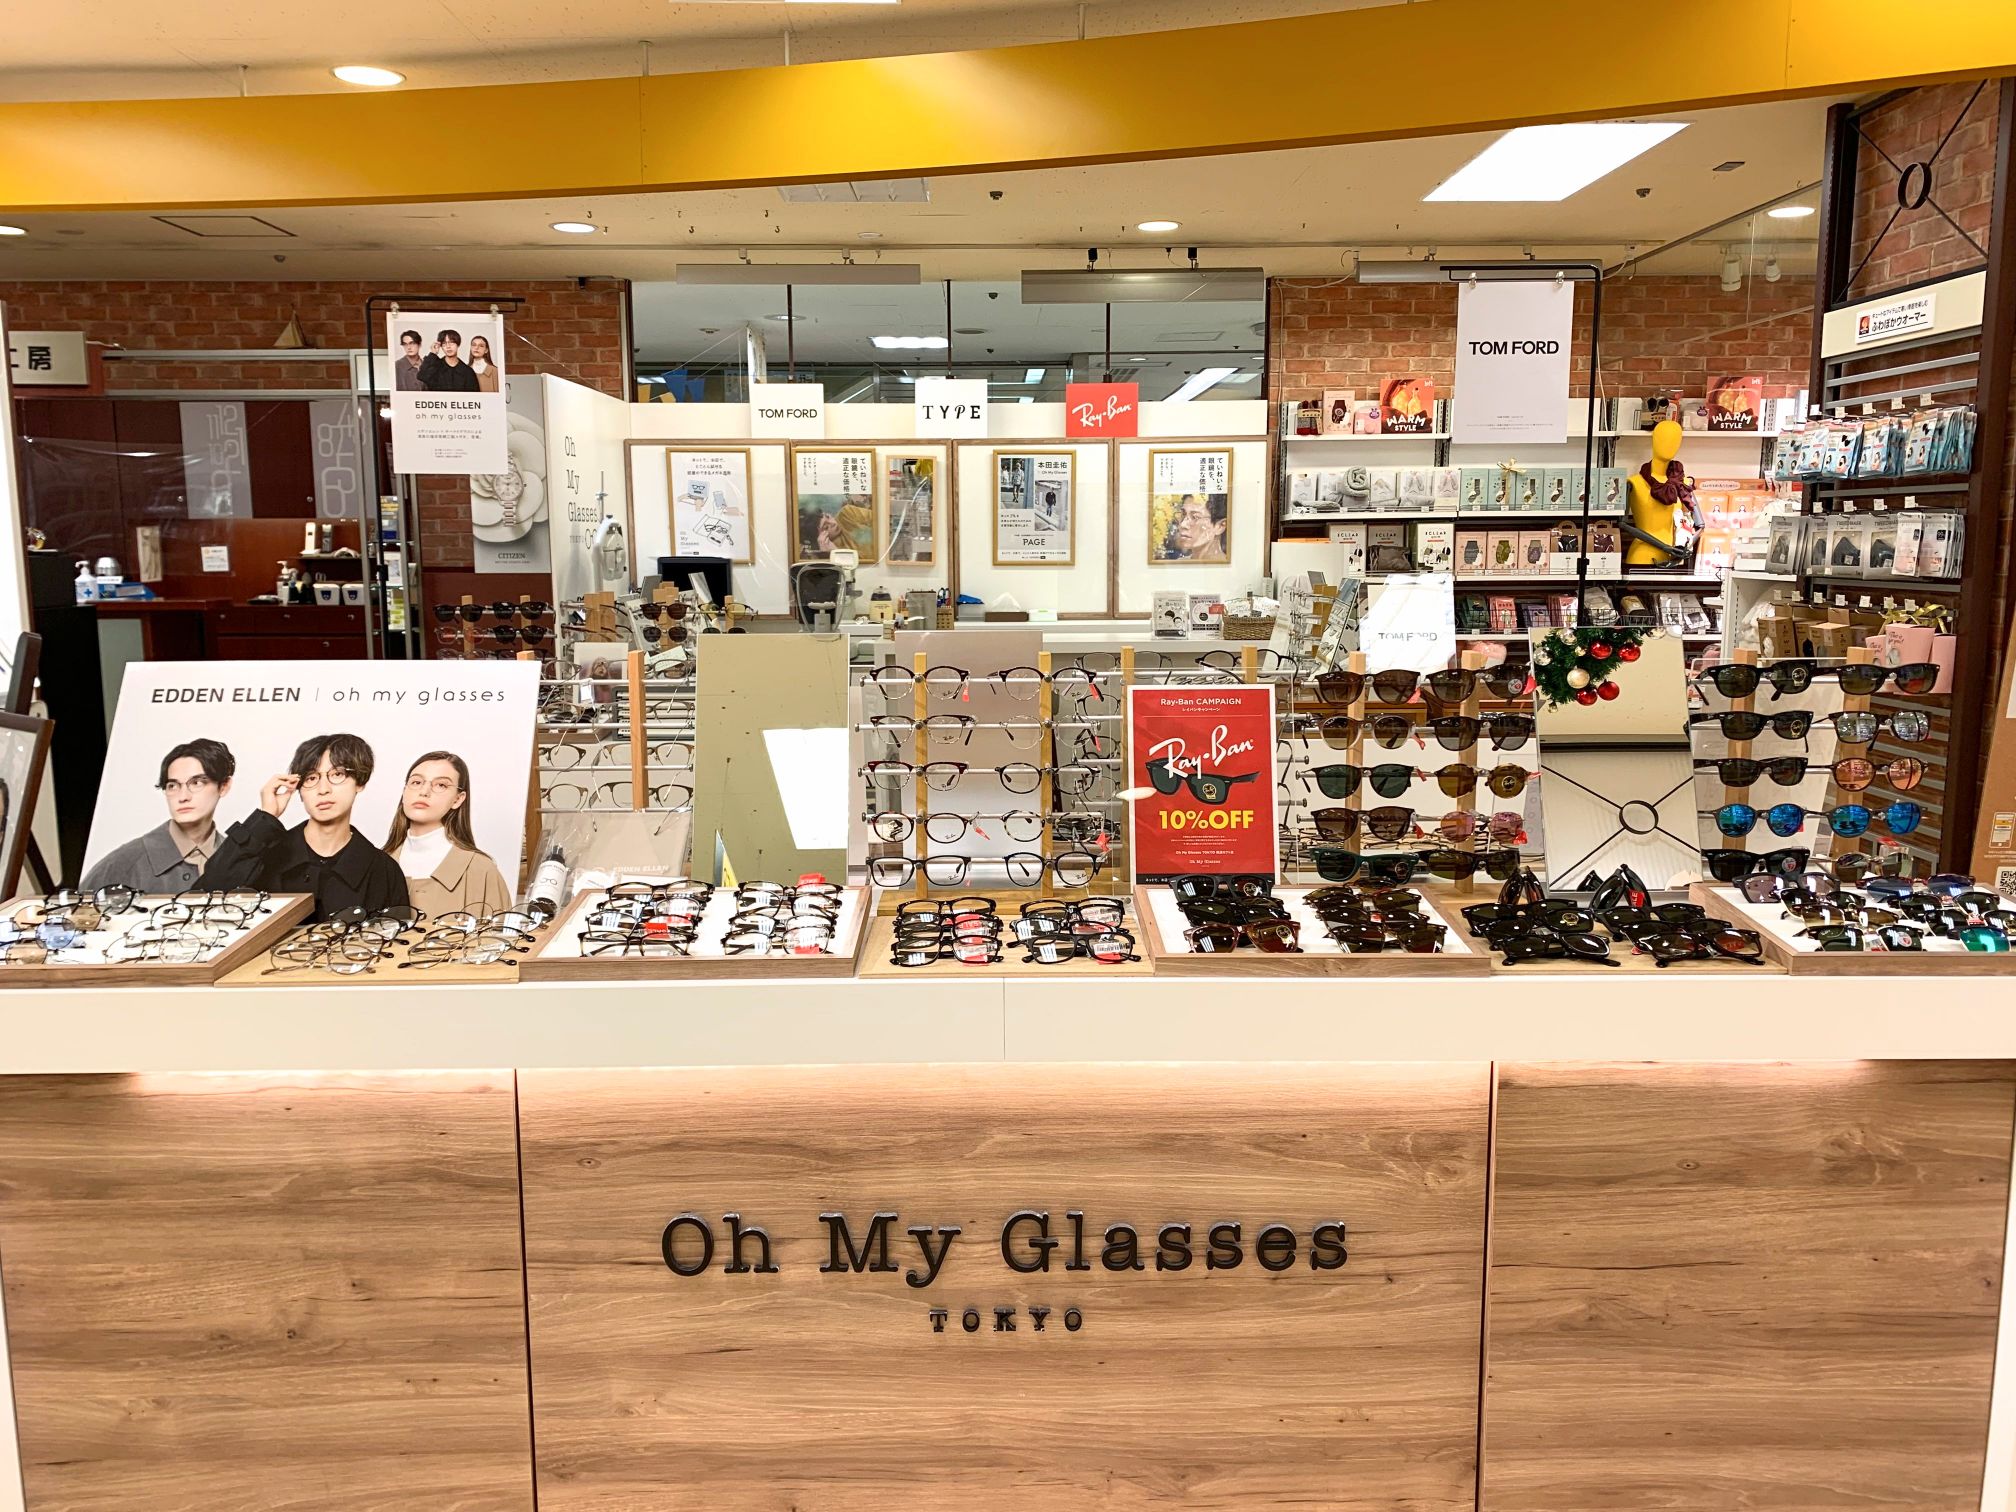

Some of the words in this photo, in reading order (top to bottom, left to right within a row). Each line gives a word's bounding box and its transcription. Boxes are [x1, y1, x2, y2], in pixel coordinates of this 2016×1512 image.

[1469, 341, 1508, 355] TOM
[1511, 340, 1560, 355] FORD
[415, 401, 447, 409] EDDEN
[922, 404, 981, 419] TYPE
[448, 413, 482, 421] glasses
[758, 408, 785, 418] TOM
[787, 408, 818, 418] FORD
[1386, 414, 1426, 427] WARM
[1711, 412, 1752, 425] WARM
[564, 435, 576, 457] Oh
[1038, 461, 1068, 469] 本田圭佑
[1216, 457, 1224, 491] ていねいな
[566, 469, 579, 495] My
[568, 502, 598, 523] Glasses
[1022, 538, 1046, 546] PAGE
[1378, 632, 1404, 640] TOM
[1406, 632, 1438, 641] FRD
[151, 688, 225, 703] EDDEN
[231, 687, 301, 702] ELLEN
[333, 687, 360, 702] oh
[373, 690, 407, 705] my
[418, 687, 505, 705] glasses
[1160, 698, 1194, 706] Ray-Ban
[1149, 724, 1255, 780] Ray-Ban
[1159, 810, 1255, 830] 10%OFF
[661, 1211, 780, 1277] Oh
[819, 1211, 962, 1288] My
[1000, 1210, 1349, 1274] Glasses
[928, 1307, 1083, 1333] TOKYO
